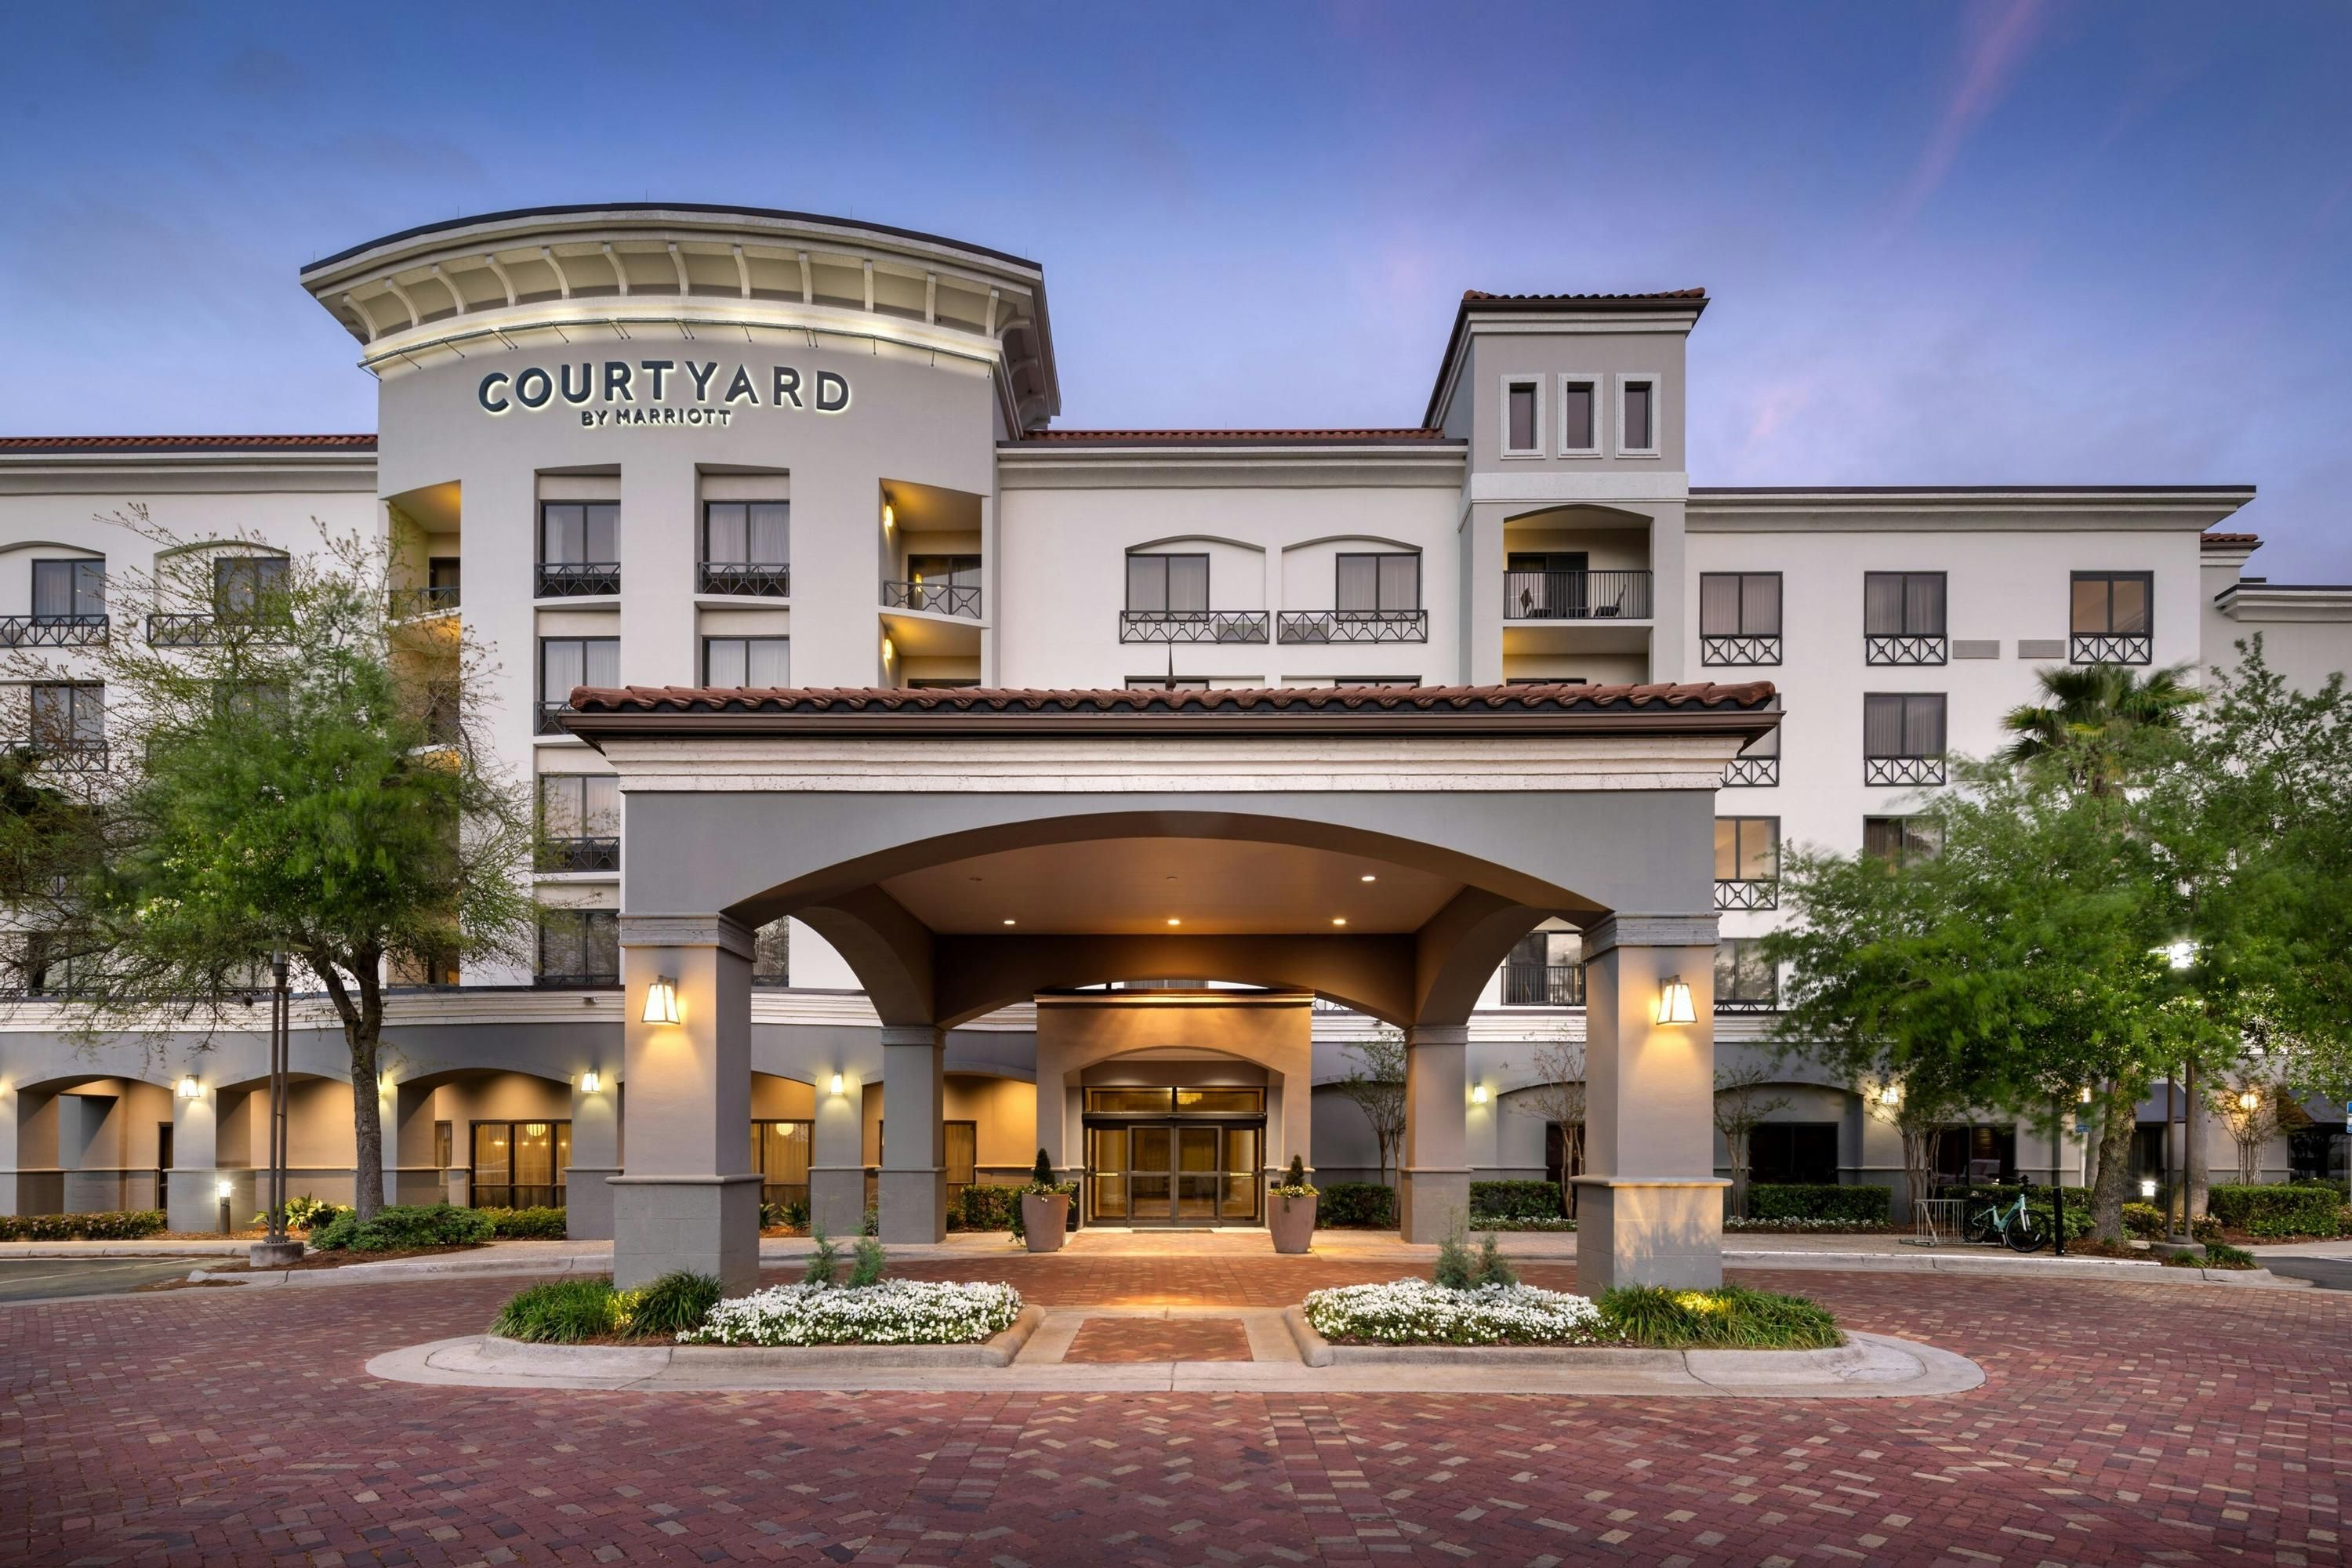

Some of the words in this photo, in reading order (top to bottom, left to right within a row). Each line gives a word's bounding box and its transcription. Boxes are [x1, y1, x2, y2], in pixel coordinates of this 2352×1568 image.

[478, 360, 851, 412] COURTYARD
[581, 410, 608, 426] BY
[616, 408, 731, 426] MARRIOTT
